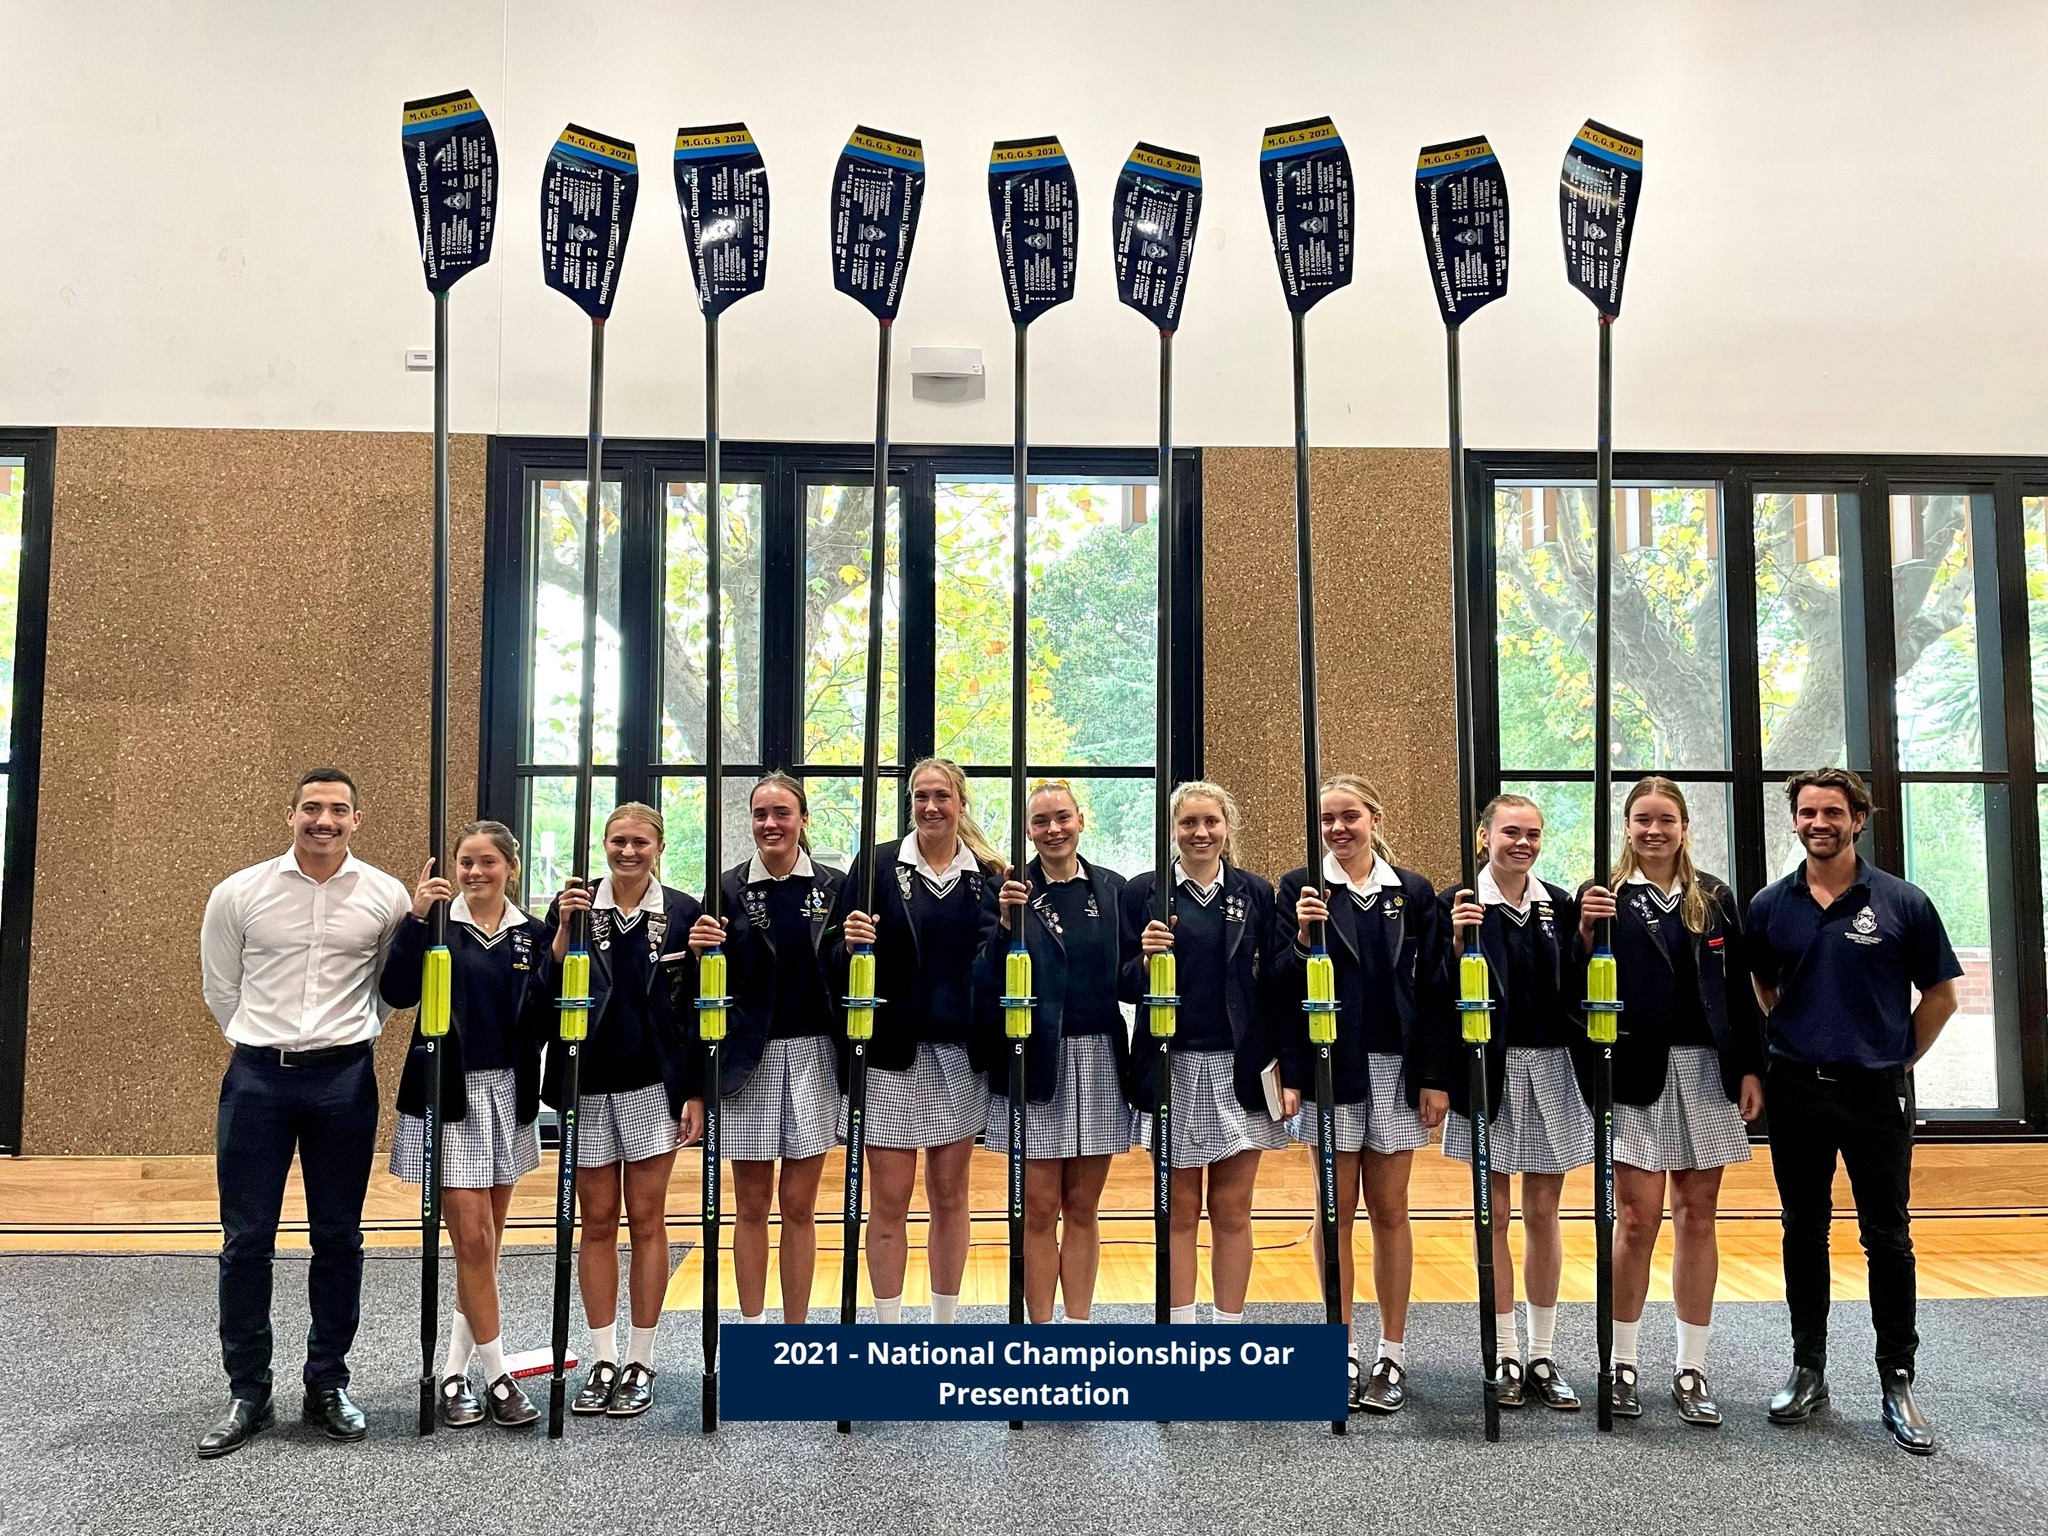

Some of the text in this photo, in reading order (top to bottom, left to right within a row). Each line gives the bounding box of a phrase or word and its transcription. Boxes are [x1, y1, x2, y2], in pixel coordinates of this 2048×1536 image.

[409, 101, 472, 121] M.G.G.S 2021
[567, 134, 630, 160] M.G.G.S 2021
[683, 135, 745, 146] M.G.G.S 2021
[855, 136, 916, 157] M.G.G.S 2021
[1268, 129, 1330, 146] M.G.G.S 2021
[1584, 130, 1637, 156] M.G.G.S 2021
[417, 141, 428, 192] Champions
[997, 148, 1056, 160] M.G.G.S 2021
[1137, 153, 1195, 173] M.G.G.S 2021
[1424, 147, 1485, 165] M.G.G.S 2021
[903, 175, 913, 221] Australian
[598, 175, 621, 305] Australian National Champions
[690, 167, 711, 302] Australian National Champions
[1276, 162, 1299, 296] Australian National Champions
[1610, 172, 1628, 303] Australian National Champions
[427, 234, 437, 279] Australian
[1004, 180, 1021, 312] Australian National Champions
[1167, 192, 1195, 319] Australian National Champions
[1434, 234, 1446, 269] National
[886, 261, 903, 306] Champions
[1440, 271, 1457, 313] Australian
[428, 1042, 434, 1052] 9
[569, 1046, 576, 1056] 8
[709, 1045, 717, 1056] 7
[856, 1045, 862, 1055] 6
[1016, 1044, 1022, 1054] 5
[1160, 1043, 1167, 1053] 4
[1321, 1047, 1328, 1058] 3
[1475, 1047, 1482, 1058] 1
[1605, 1048, 1611, 1058] 2
[565, 1126, 573, 1165] concept
[1323, 1112, 1332, 1154] SKINNY
[1478, 1114, 1486, 1155] SKINNY
[849, 1178, 857, 1219] SKINNY
[1480, 1169, 1488, 1209] concept
